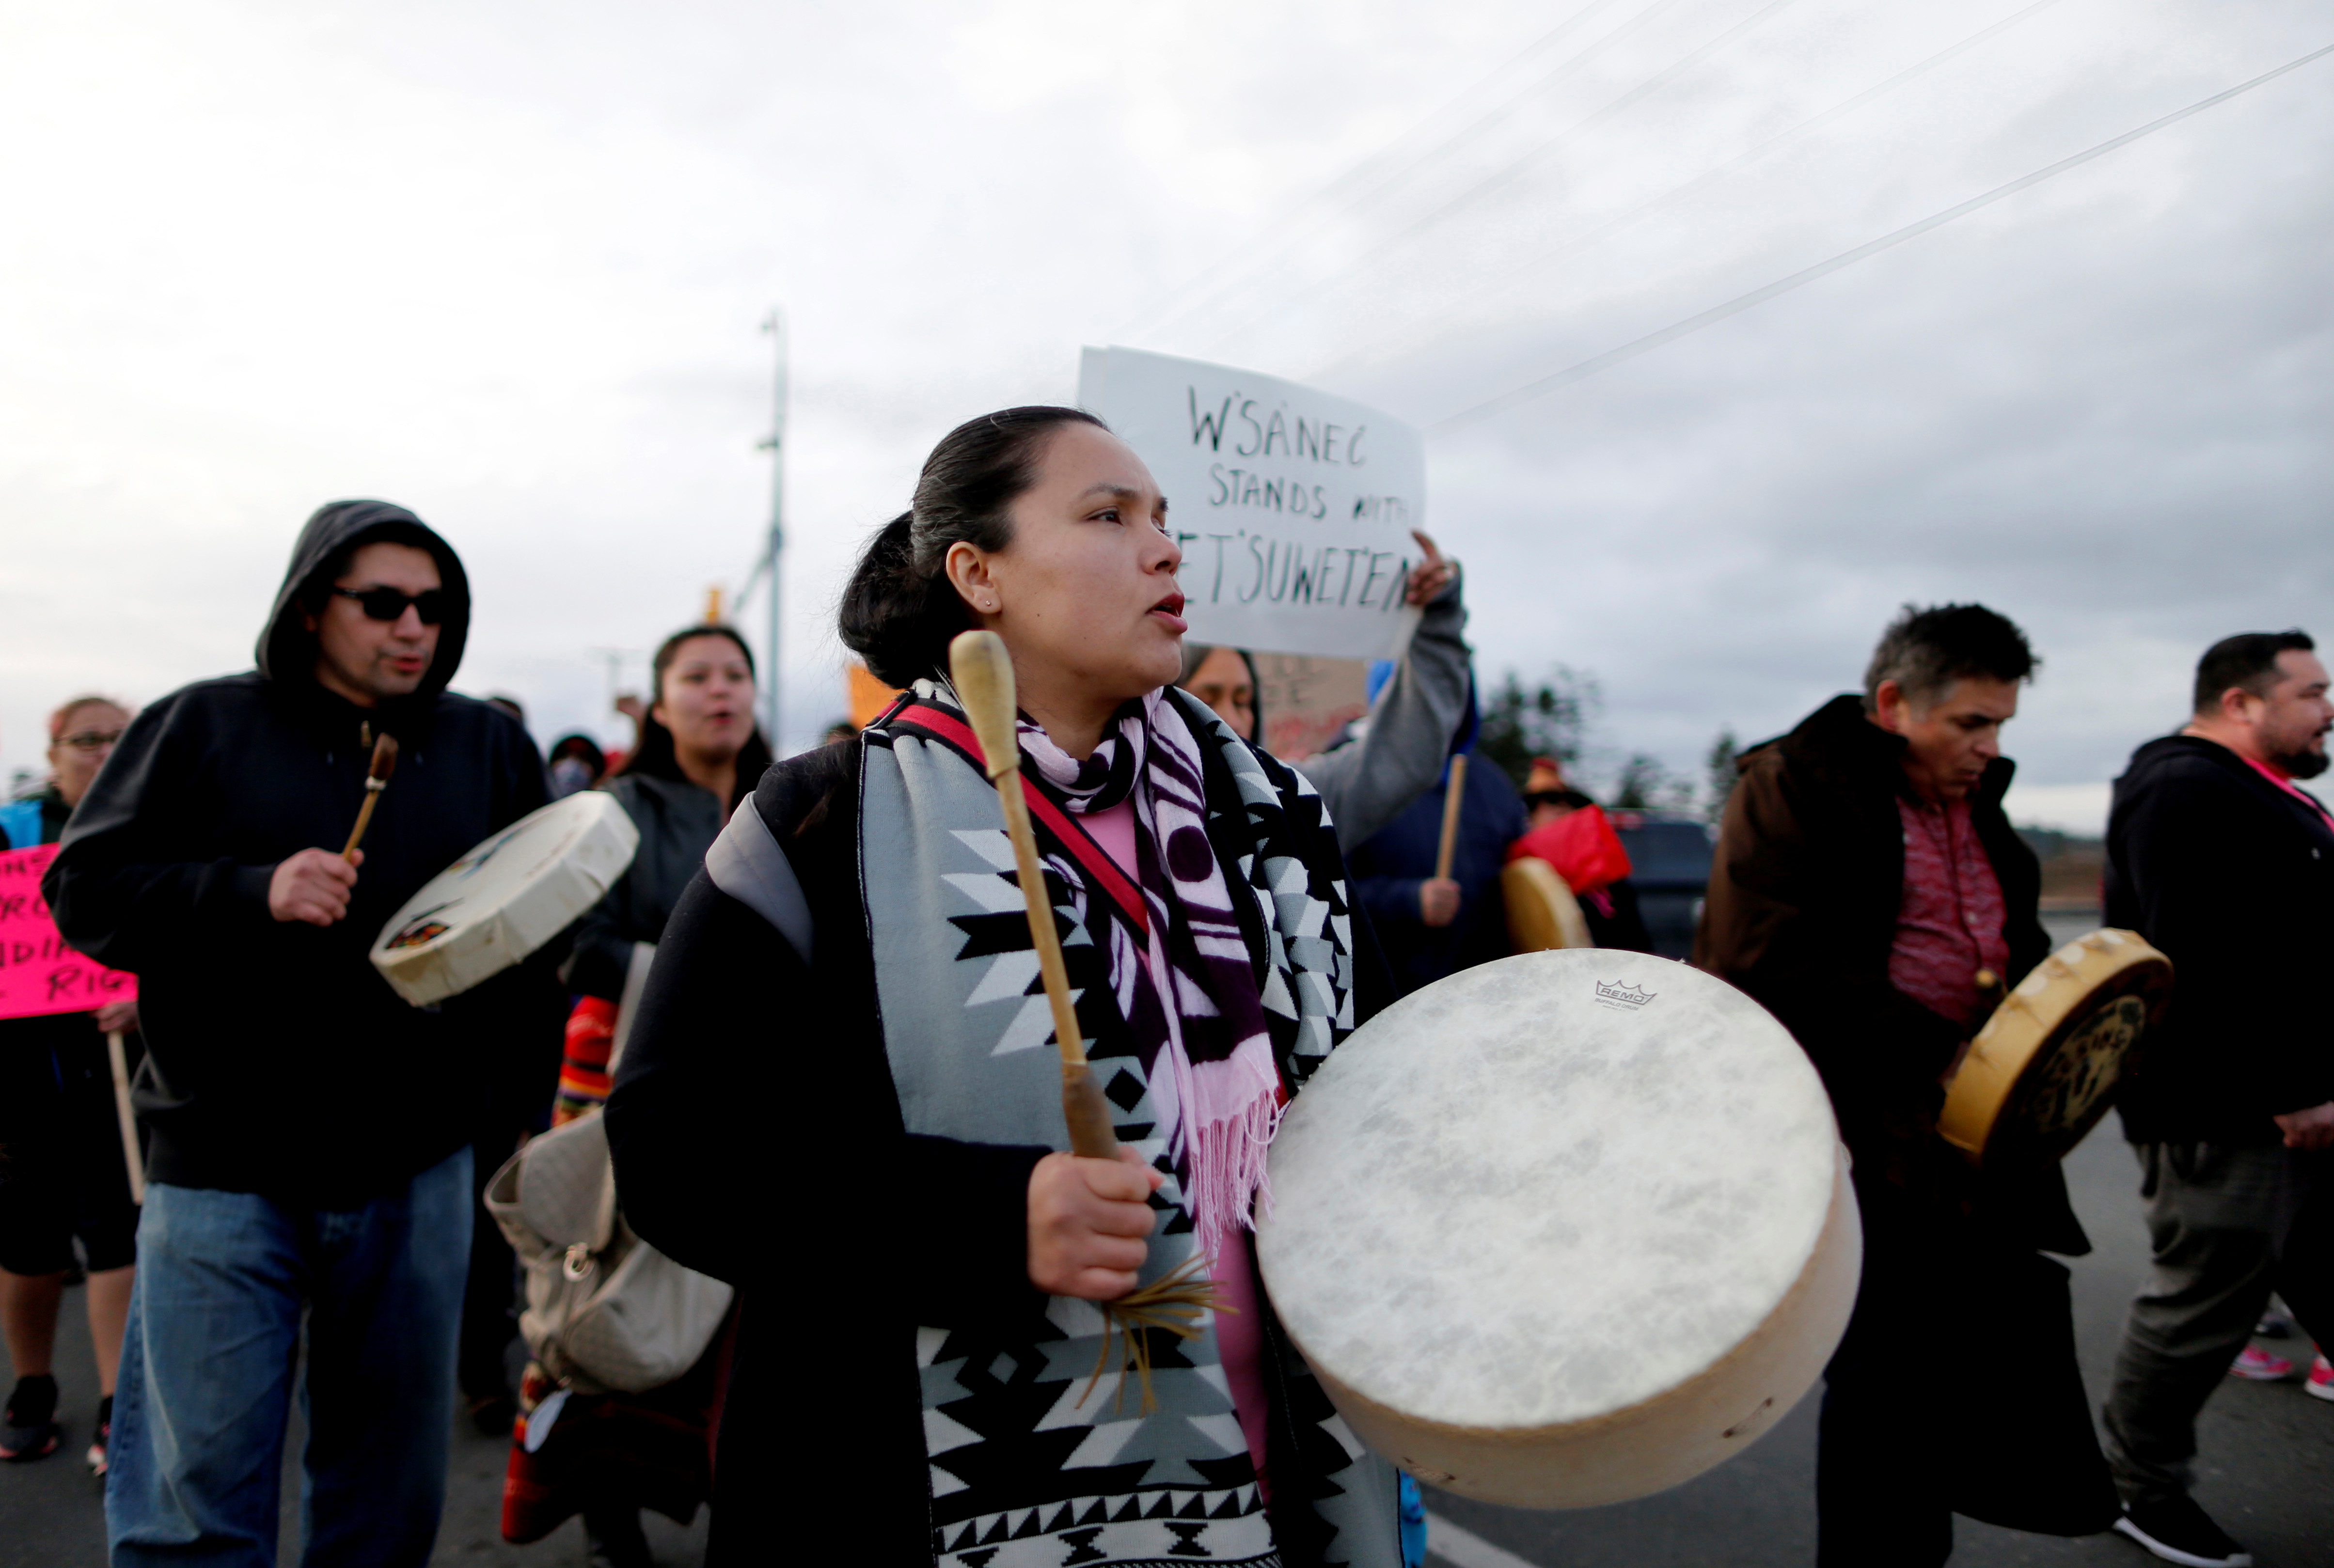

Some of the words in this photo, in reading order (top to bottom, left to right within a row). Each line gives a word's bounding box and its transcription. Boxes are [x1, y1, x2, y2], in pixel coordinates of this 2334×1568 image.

[1209, 462, 1327, 519] STANDS
[47, 966, 125, 1001] RIG
[1601, 988, 1644, 1002] REMO
[1595, 998, 1621, 1007] BUFFALO
